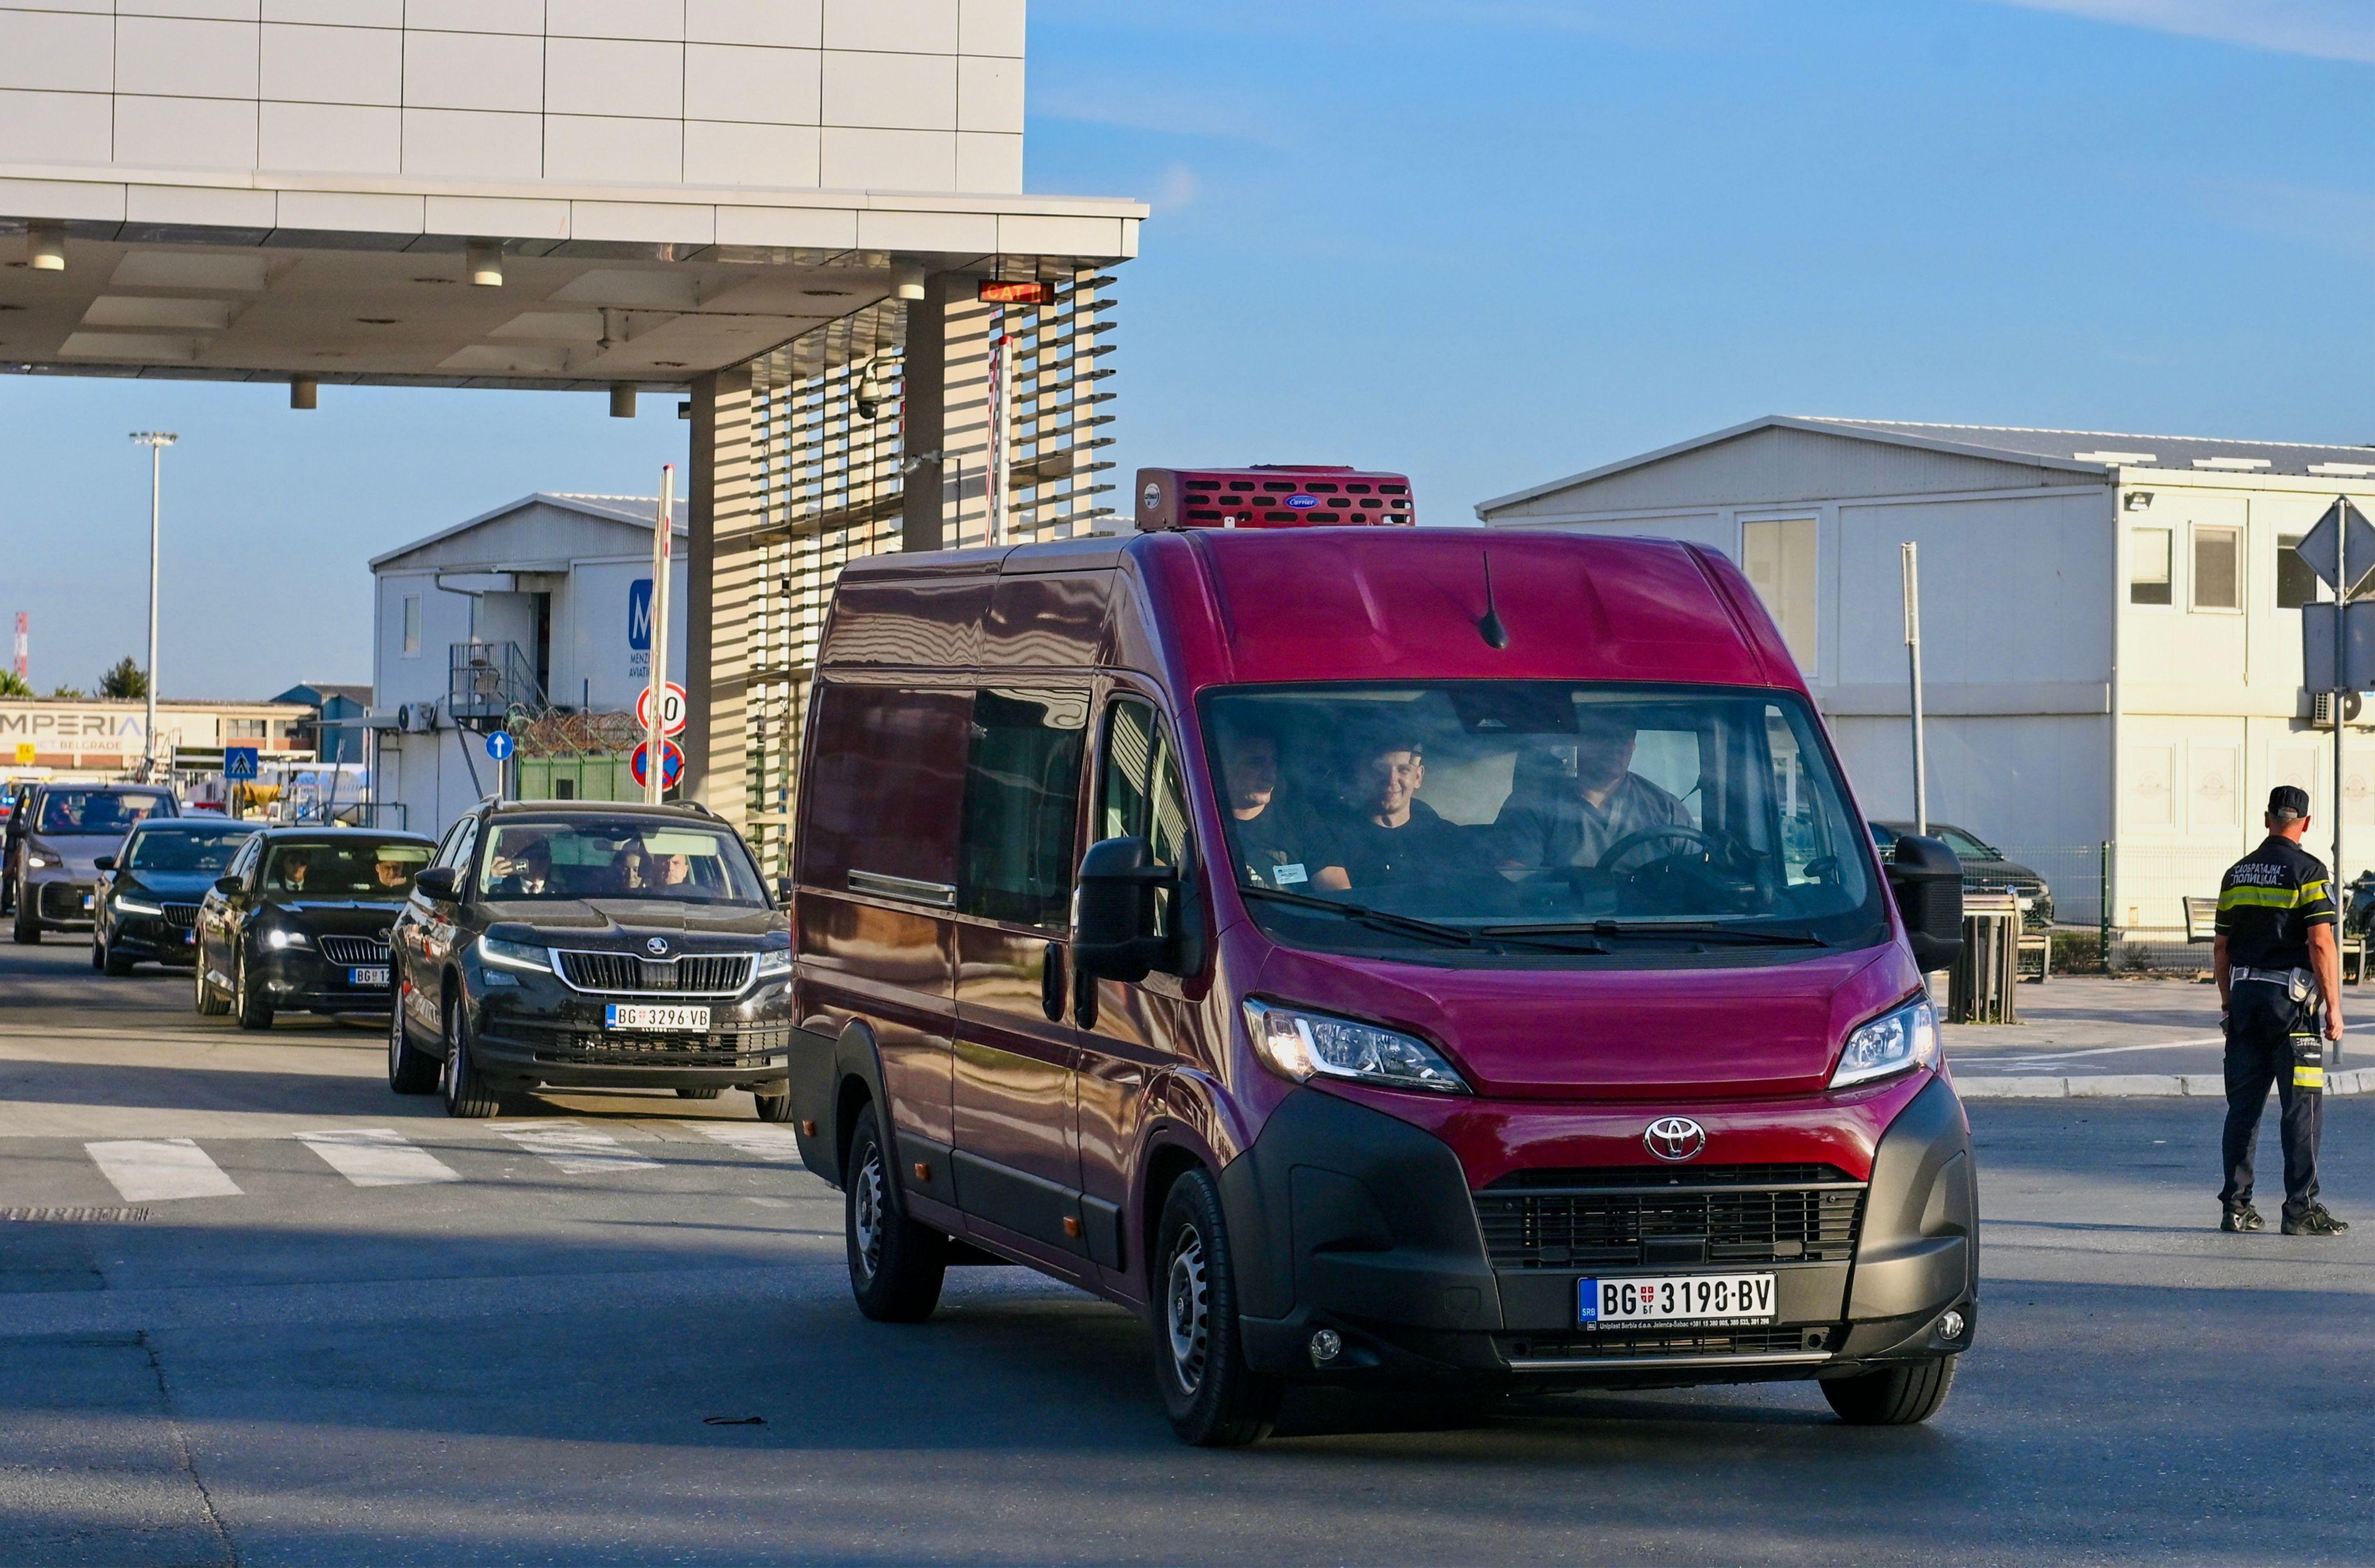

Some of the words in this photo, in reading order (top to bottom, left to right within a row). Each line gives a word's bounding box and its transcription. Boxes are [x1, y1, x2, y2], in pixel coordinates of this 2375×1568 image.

[987, 285, 1024, 300] CAT
[630, 653, 650, 664] MENZI
[664, 697, 678, 721] 0
[60, 741, 122, 750] BELGRADE
[2233, 873, 2277, 886] ПОЛИЦИЈА
[357, 970, 371, 981] BG
[380, 970, 390, 982] 12
[619, 1009, 636, 1024] BG
[1603, 1283, 1636, 1315] BG
[1582, 1308, 1596, 1316] SRB
